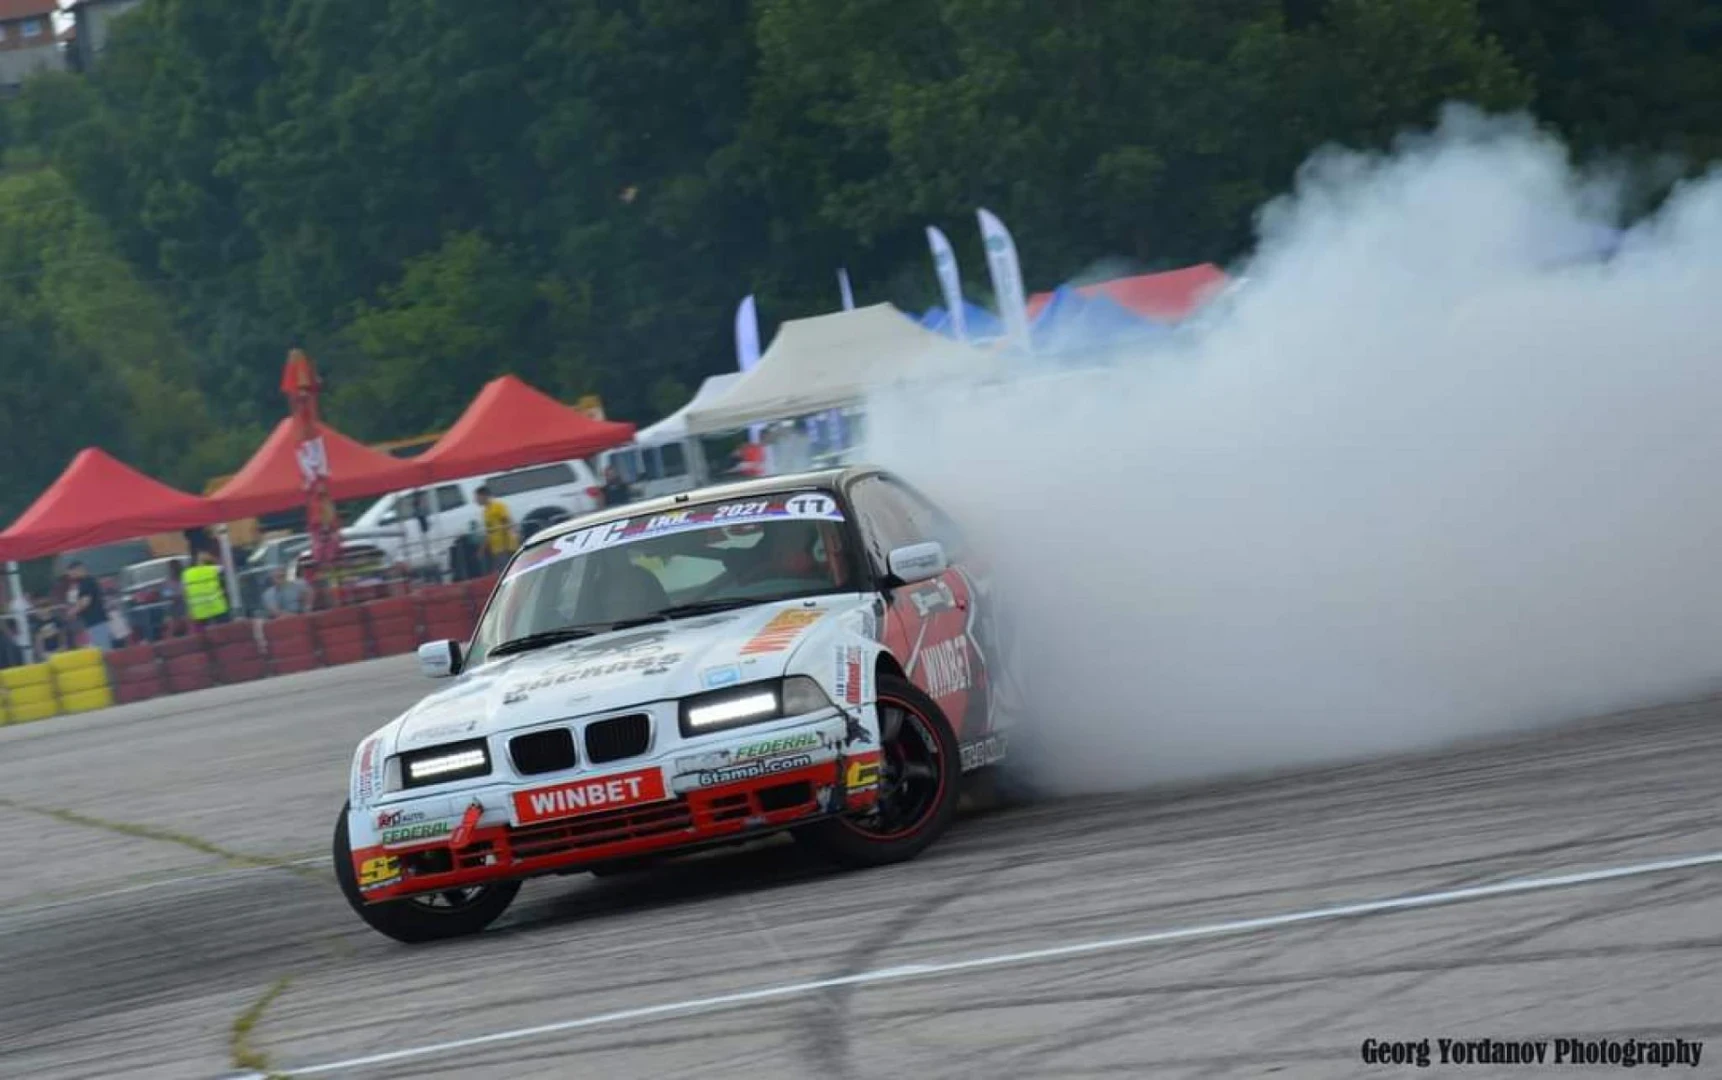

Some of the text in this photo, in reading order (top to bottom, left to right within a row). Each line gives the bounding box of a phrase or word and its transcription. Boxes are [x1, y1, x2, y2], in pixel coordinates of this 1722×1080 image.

[713, 500, 769, 518] 2021
[789, 498, 833, 514] 77
[920, 634, 972, 699] WINBET
[735, 731, 818, 760] FEDERAL
[530, 776, 643, 815] WINBET
[382, 821, 451, 846] FEDERAL
